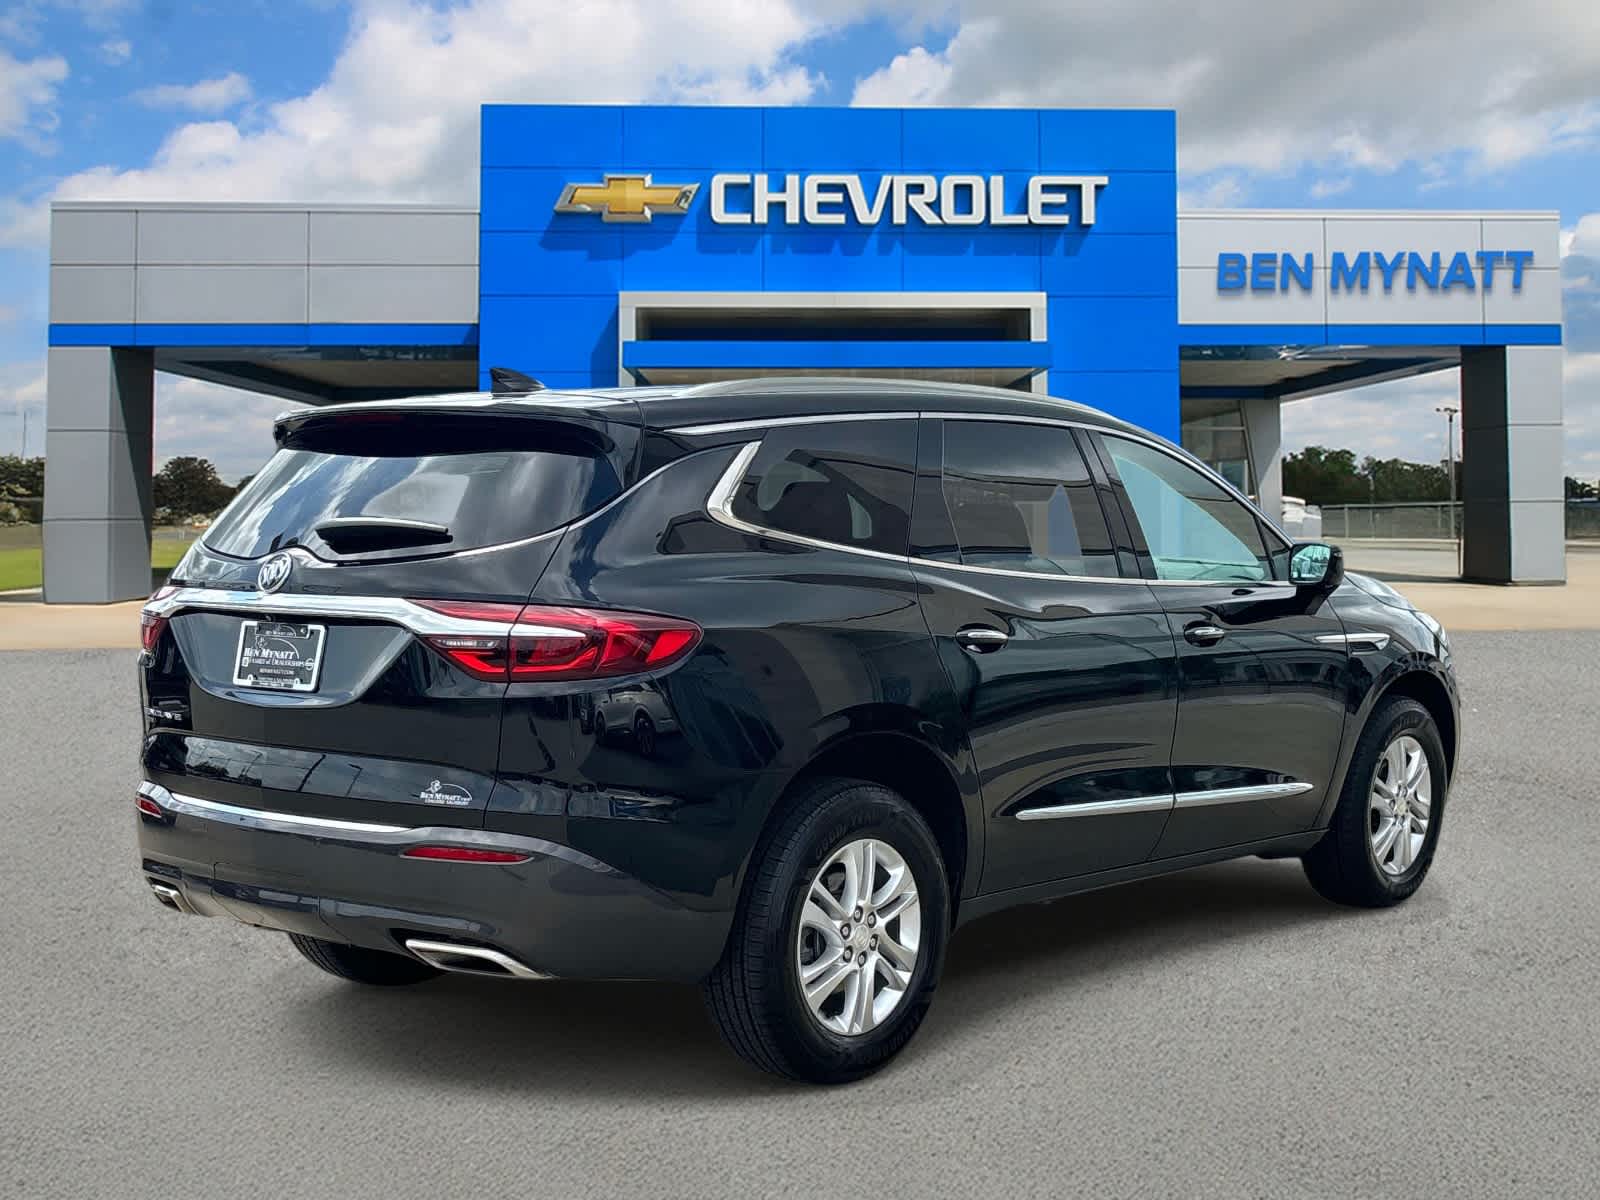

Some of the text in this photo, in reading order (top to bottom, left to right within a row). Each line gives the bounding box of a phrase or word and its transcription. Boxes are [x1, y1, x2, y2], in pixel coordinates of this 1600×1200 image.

[710, 173, 1110, 226] CHEVROLET
[1216, 250, 1535, 291] BEN MYNATT
[244, 647, 296, 660] BEN MYNATT
